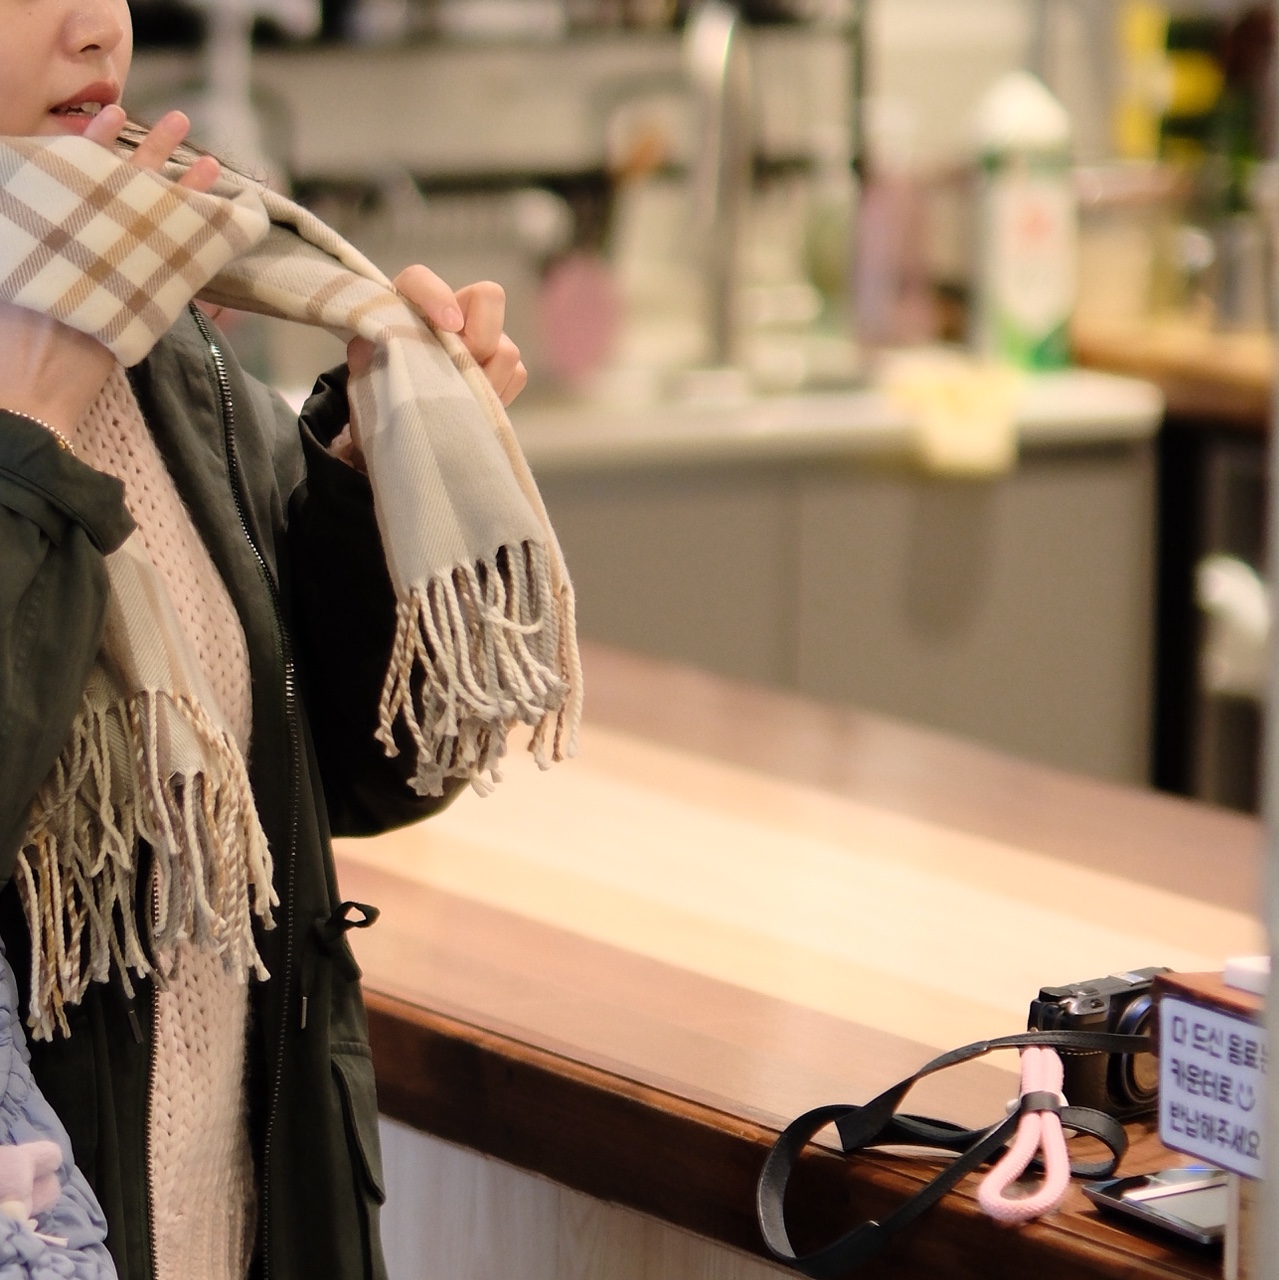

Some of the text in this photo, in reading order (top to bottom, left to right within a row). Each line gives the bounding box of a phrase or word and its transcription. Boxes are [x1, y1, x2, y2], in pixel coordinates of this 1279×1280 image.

[1192, 1023, 1223, 1058] 드신
[1171, 1058, 1233, 1104] 카운터로
[1170, 1101, 1260, 1158] 반납해주세요
